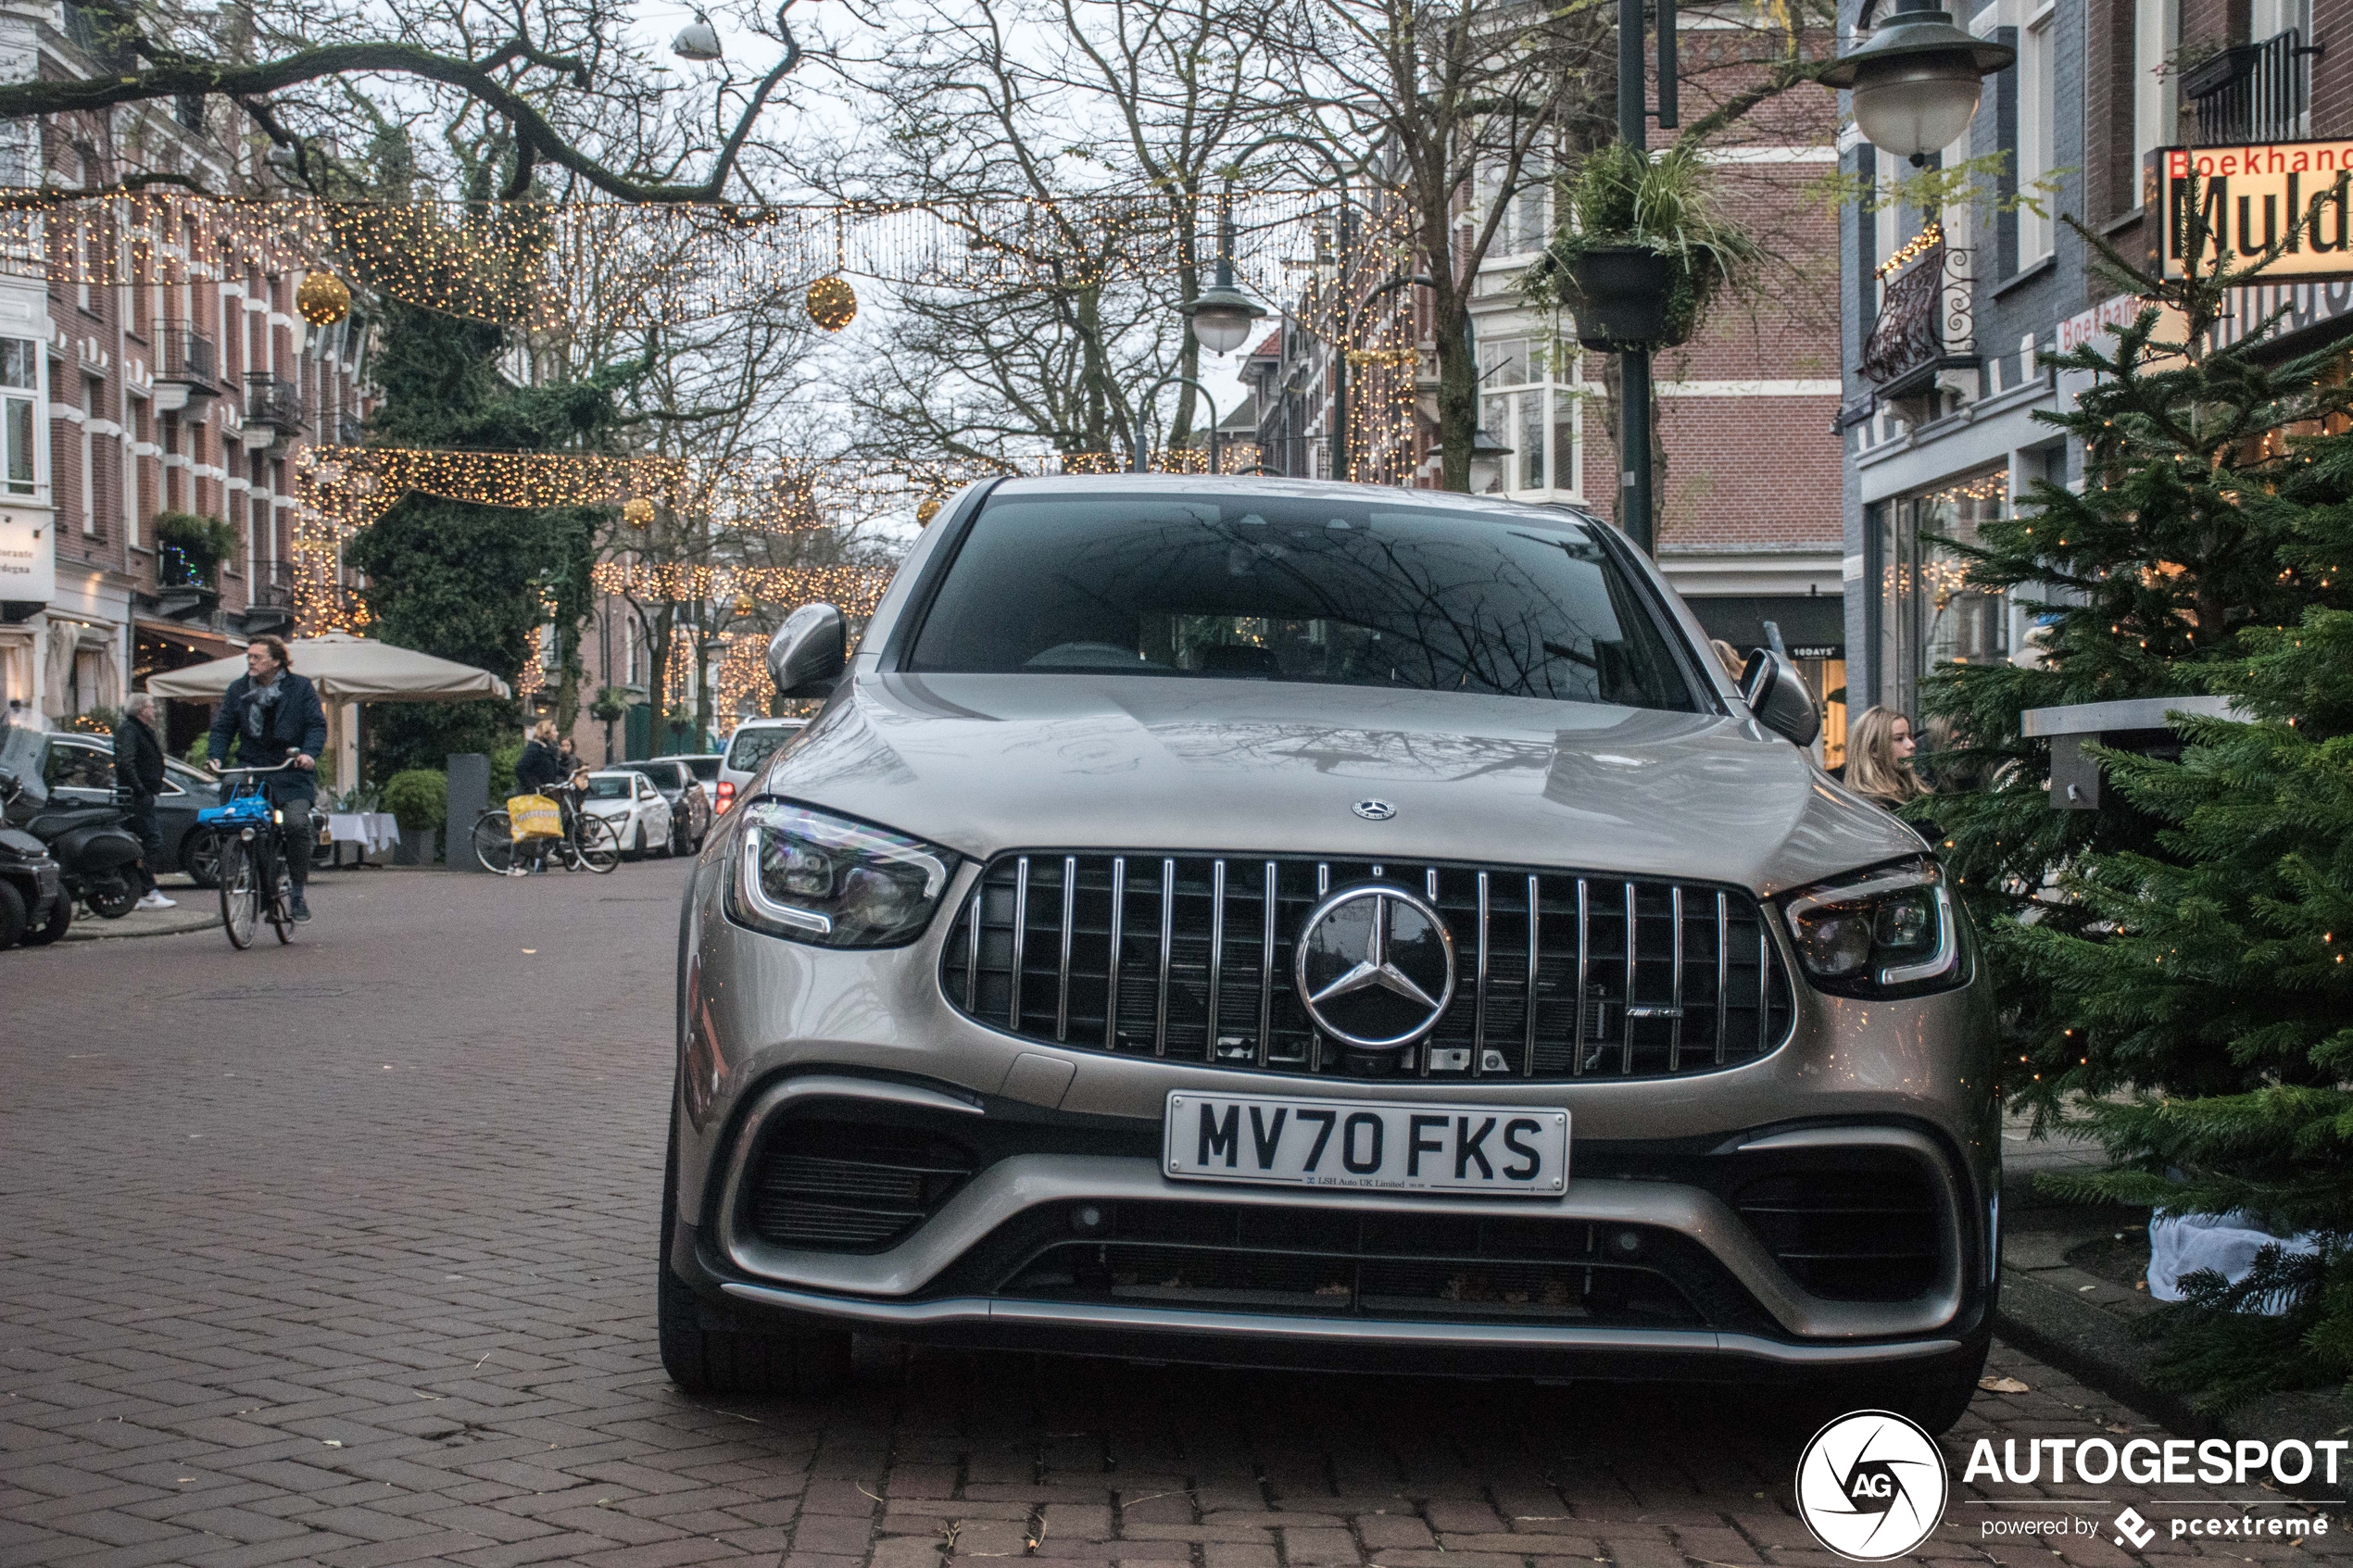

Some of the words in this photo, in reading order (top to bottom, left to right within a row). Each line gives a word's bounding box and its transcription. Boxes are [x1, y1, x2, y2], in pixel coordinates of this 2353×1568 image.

[1197, 1102, 1384, 1175] MV70
[1406, 1113, 1542, 1182] FKS
[1318, 1176, 1336, 1185] LSH
[1375, 1180, 1405, 1188] Limited
